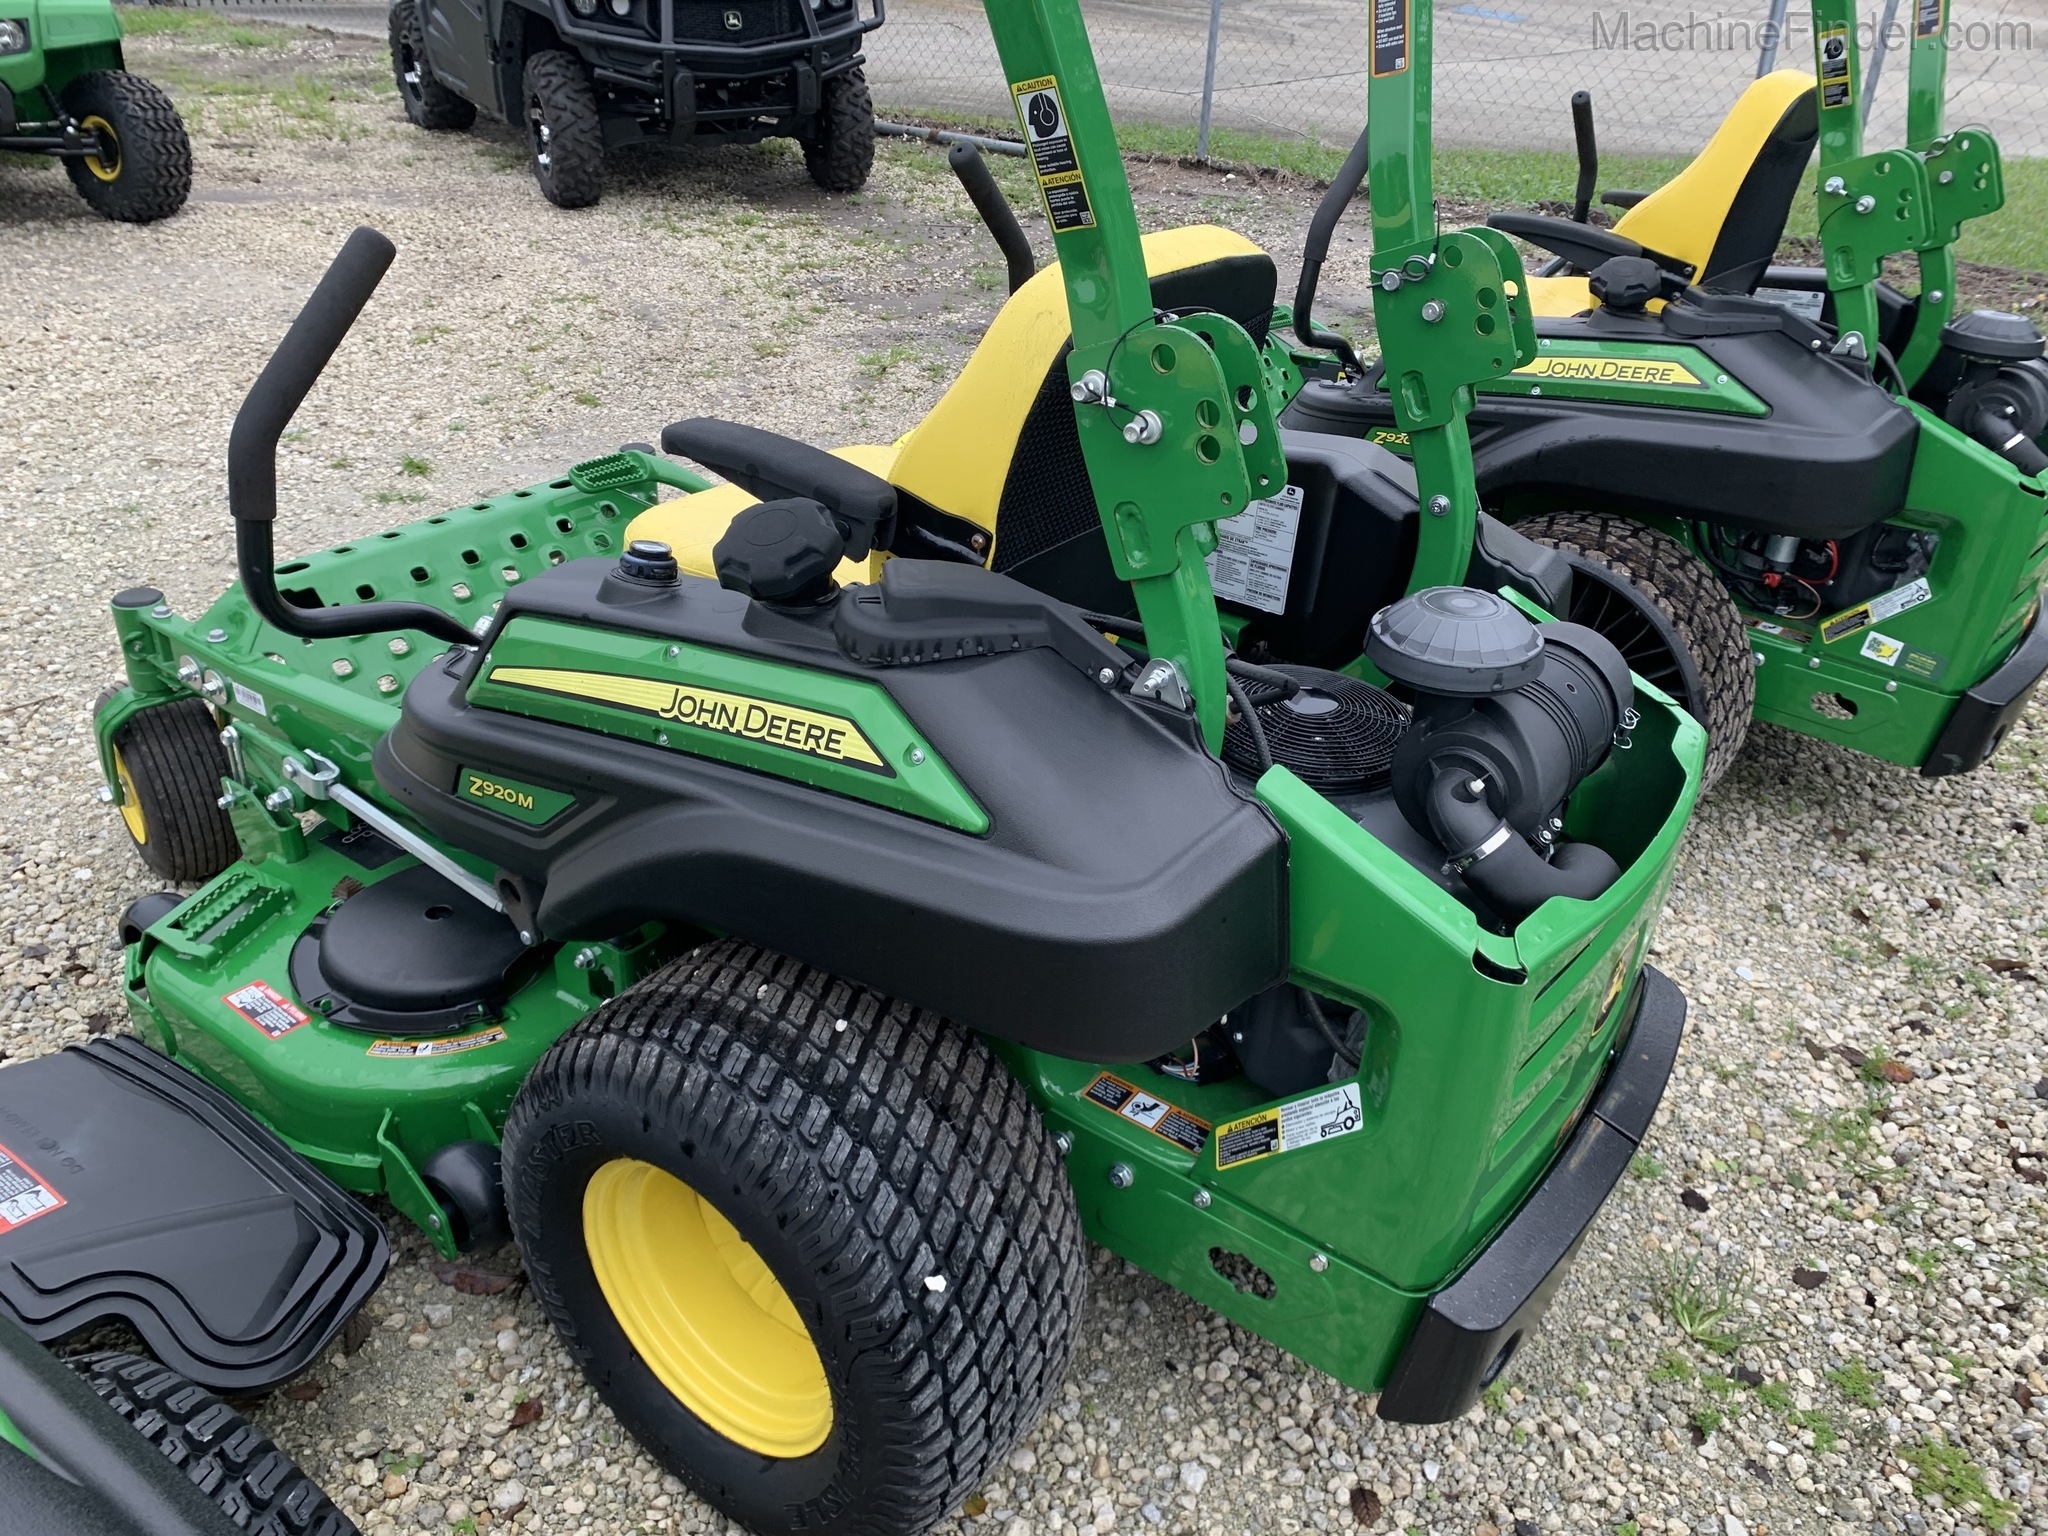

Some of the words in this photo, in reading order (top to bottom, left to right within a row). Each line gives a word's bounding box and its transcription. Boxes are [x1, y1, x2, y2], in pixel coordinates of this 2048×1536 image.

[1021, 78, 1053, 91] CAUTION
[1047, 172, 1081, 185] ATENCIÓN
[1537, 359, 1601, 377] JOHN
[1600, 361, 1675, 382] DEERE
[660, 688, 739, 729] JOHN
[743, 704, 847, 755] DEERE
[469, 776, 533, 810] Z920M
[1234, 1113, 1267, 1131] ATENCIÓN
[60, 1156, 85, 1175] DO
[520, 1119, 602, 1240] MASTER
